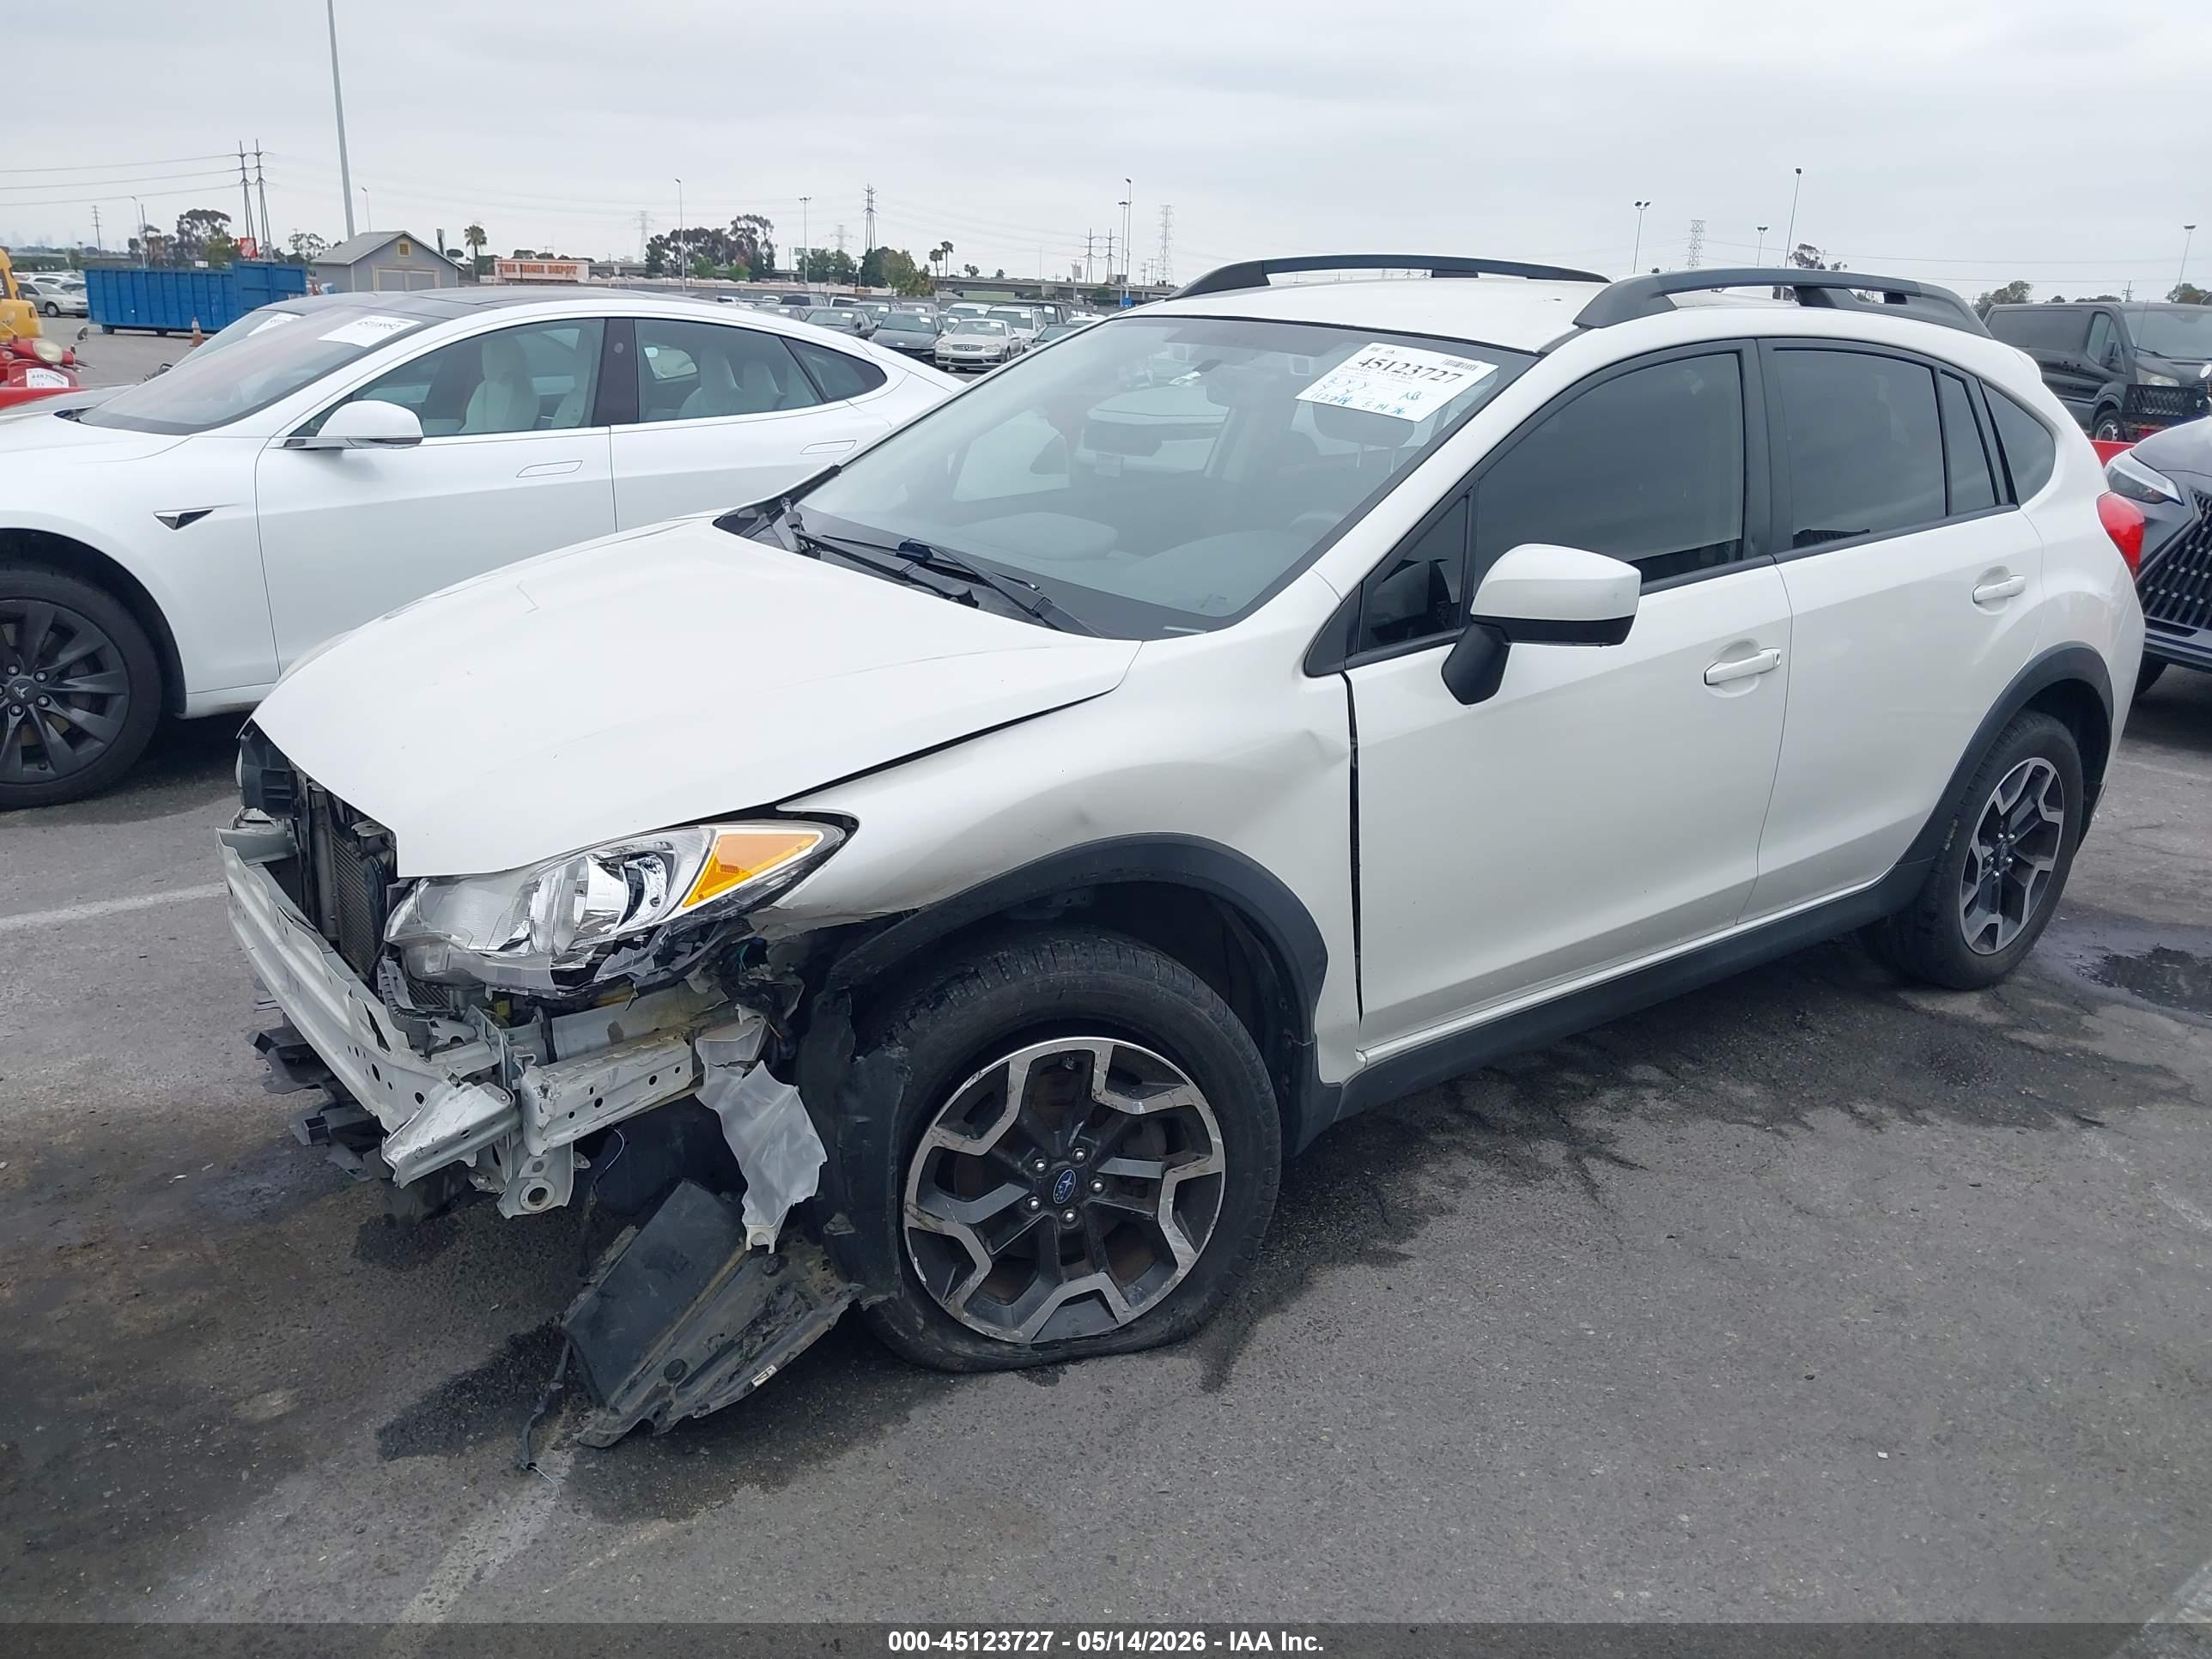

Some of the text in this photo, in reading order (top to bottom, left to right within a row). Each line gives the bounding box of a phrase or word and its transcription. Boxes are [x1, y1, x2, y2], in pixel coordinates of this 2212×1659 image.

[521, 264, 544, 273] HOME
[547, 264, 578, 274] DEPOT
[1358, 356, 1463, 384] 45123727
